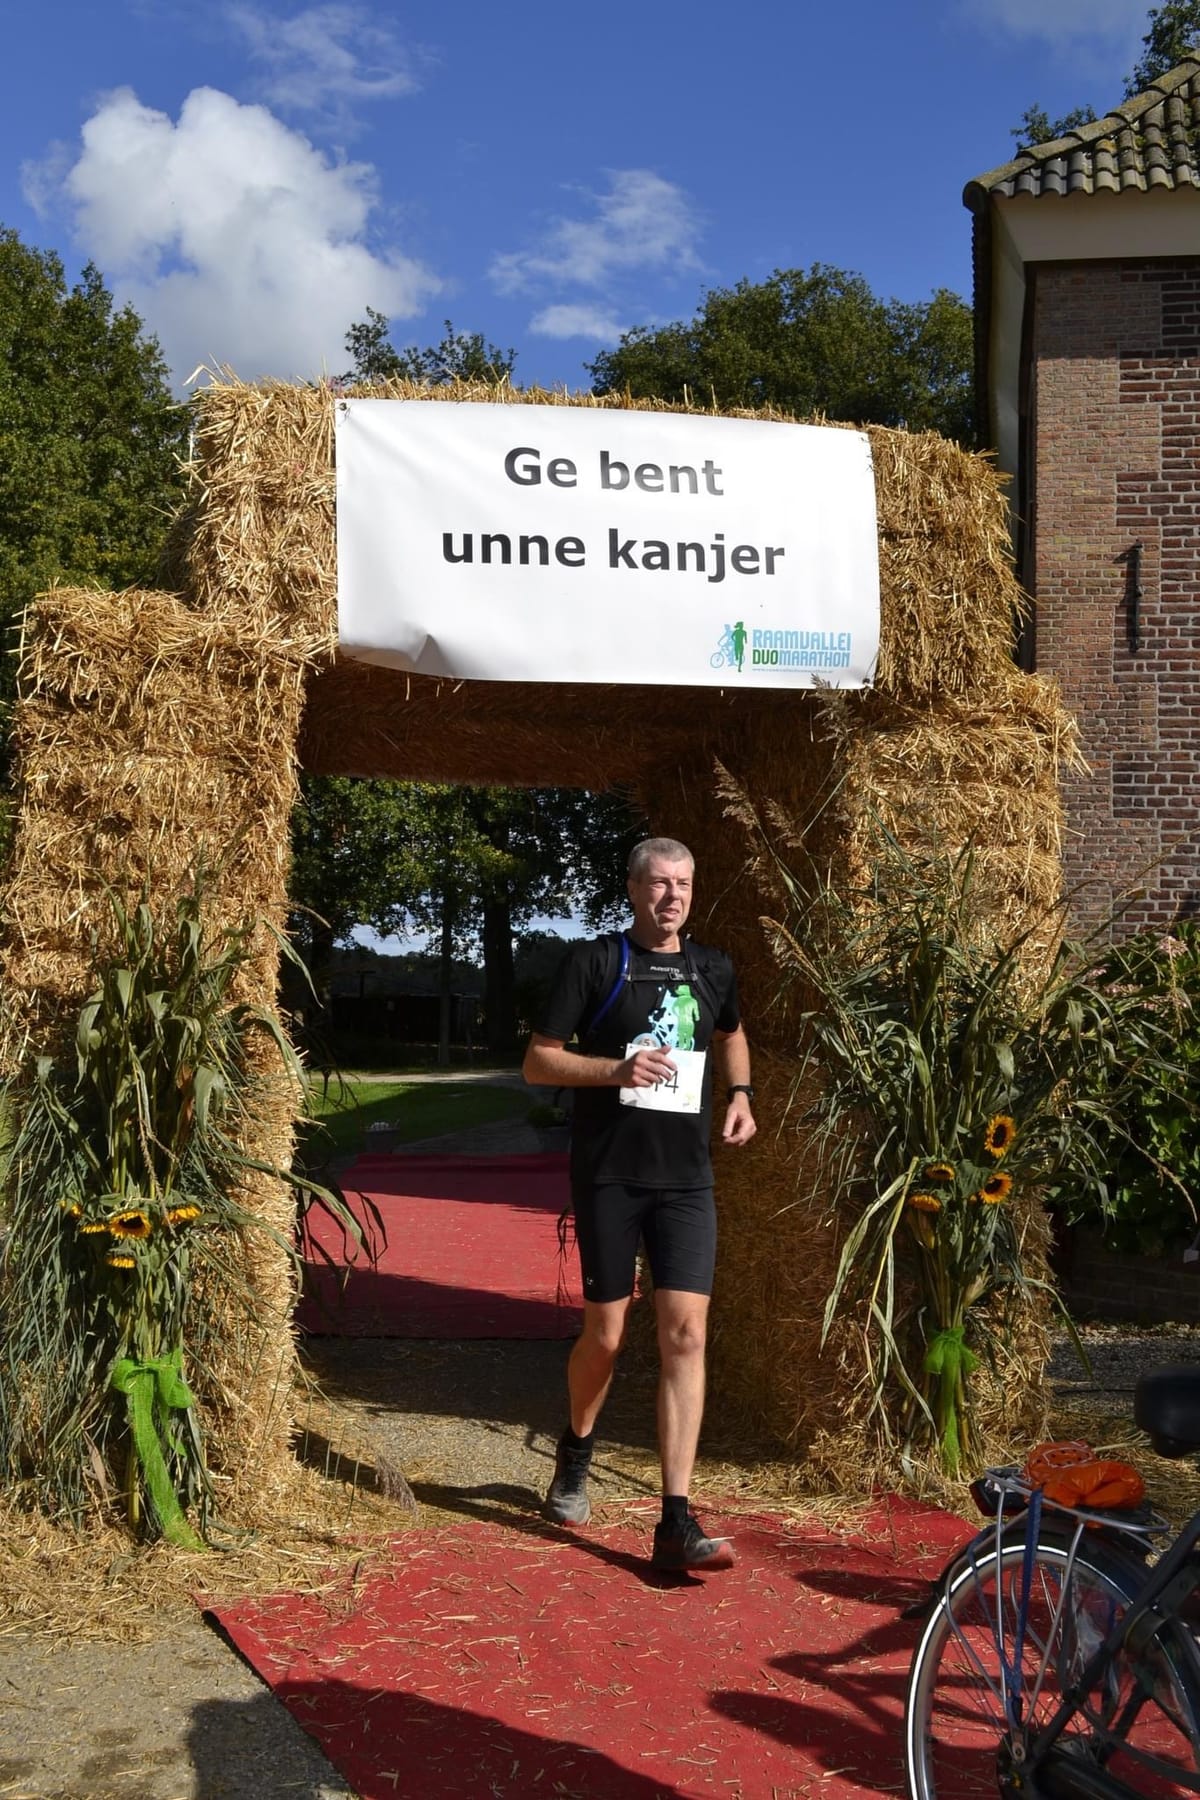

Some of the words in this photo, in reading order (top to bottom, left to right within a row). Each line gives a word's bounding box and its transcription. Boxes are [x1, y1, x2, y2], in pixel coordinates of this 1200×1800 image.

[505, 447, 576, 487] Ge
[600, 451, 723, 495] bent
[443, 533, 585, 567] unne
[609, 528, 784, 583] kanjer
[752, 629, 852, 651] RAAMVALLEI
